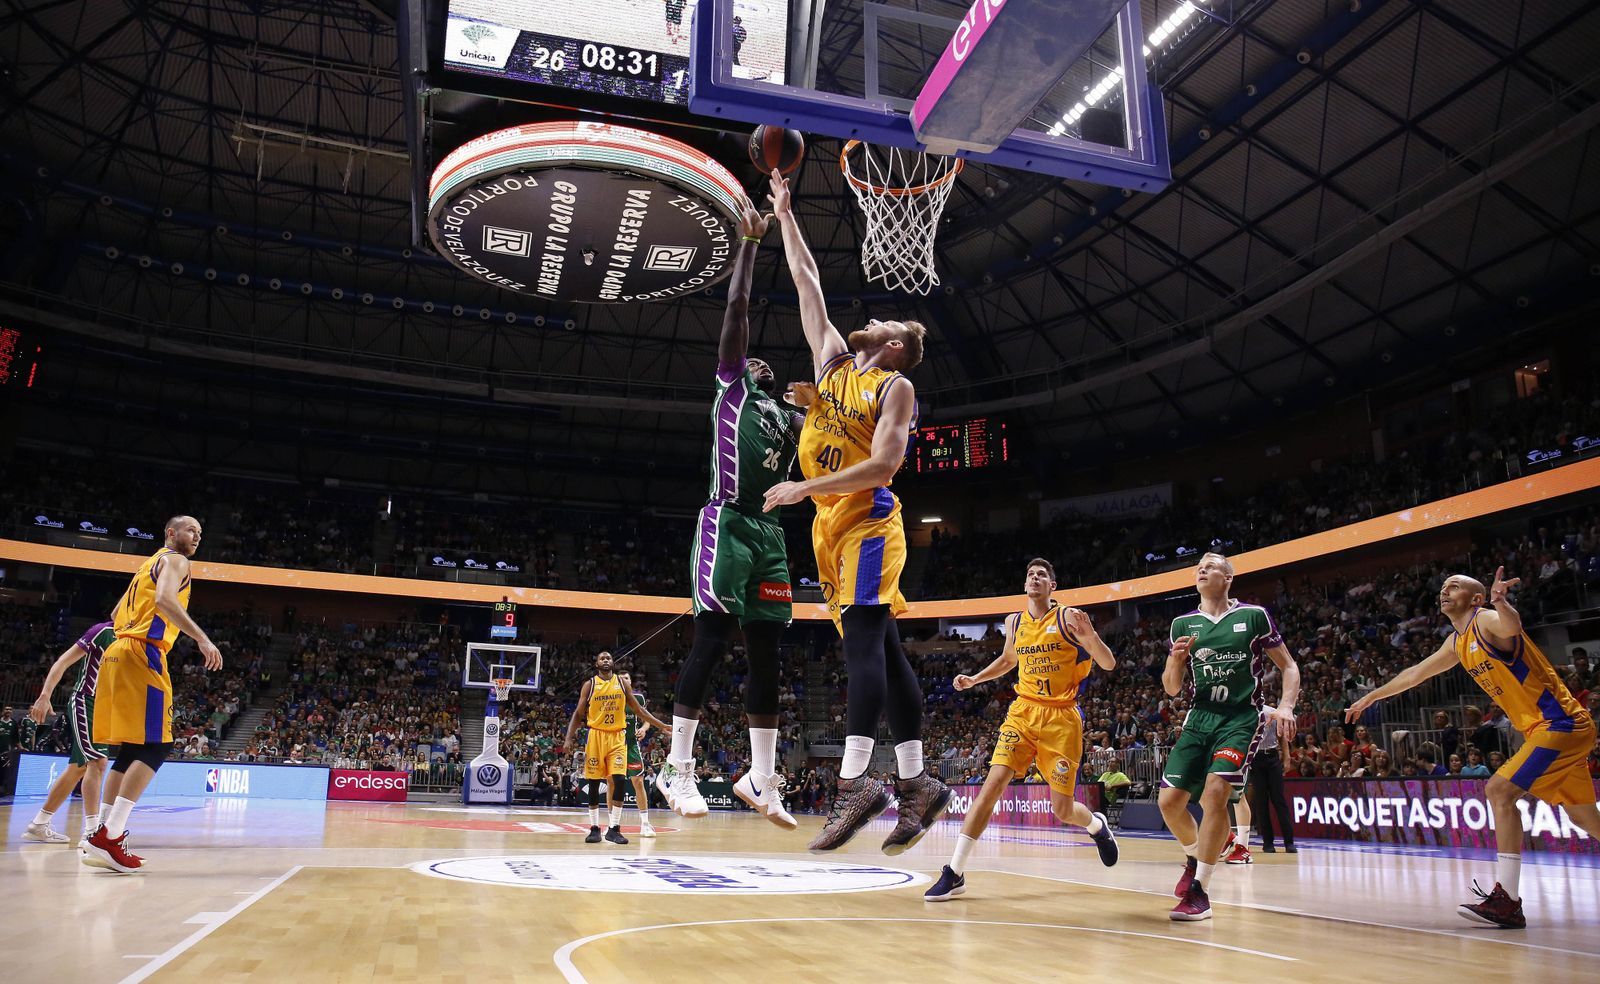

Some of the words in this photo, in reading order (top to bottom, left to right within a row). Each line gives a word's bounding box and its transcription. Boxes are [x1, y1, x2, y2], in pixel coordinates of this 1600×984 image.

[460, 49, 496, 63] Unicaja
[532, 47, 565, 72] 26
[581, 43, 658, 77] 08:31
[673, 69, 686, 89] 1
[453, 176, 538, 216] PORTICO
[548, 180, 578, 234] GRUPO
[443, 215, 464, 233] DE
[613, 189, 652, 252] RESERVA
[668, 194, 729, 265] VELAZQUEZ
[544, 235, 569, 252] LA
[444, 233, 526, 290] VELAZQUEZ
[608, 254, 633, 269] LA
[536, 252, 565, 295] RESERVA
[698, 264, 723, 277] DE
[598, 270, 627, 300] GRUPO
[622, 277, 704, 301] PORTICO
[926, 432, 936, 440] 26
[762, 447, 782, 472] 26
[816, 444, 843, 473] 40
[931, 447, 952, 457] 08:31
[495, 602, 516, 611] 08:31
[505, 613, 514, 627] 9
[1016, 642, 1062, 655] HERBALIFE
[1216, 651, 1247, 662] Unicaja
[1024, 662, 1060, 675] Canaria
[1026, 655, 1051, 665] Gran
[1037, 678, 1052, 696] 21
[1210, 685, 1229, 703] 10
[604, 714, 615, 724] 23
[219, 769, 249, 794] NBA
[335, 774, 406, 789] endesa
[705, 795, 732, 806] nicaja
[1002, 800, 1014, 812] no
[1015, 796, 1031, 812] has
